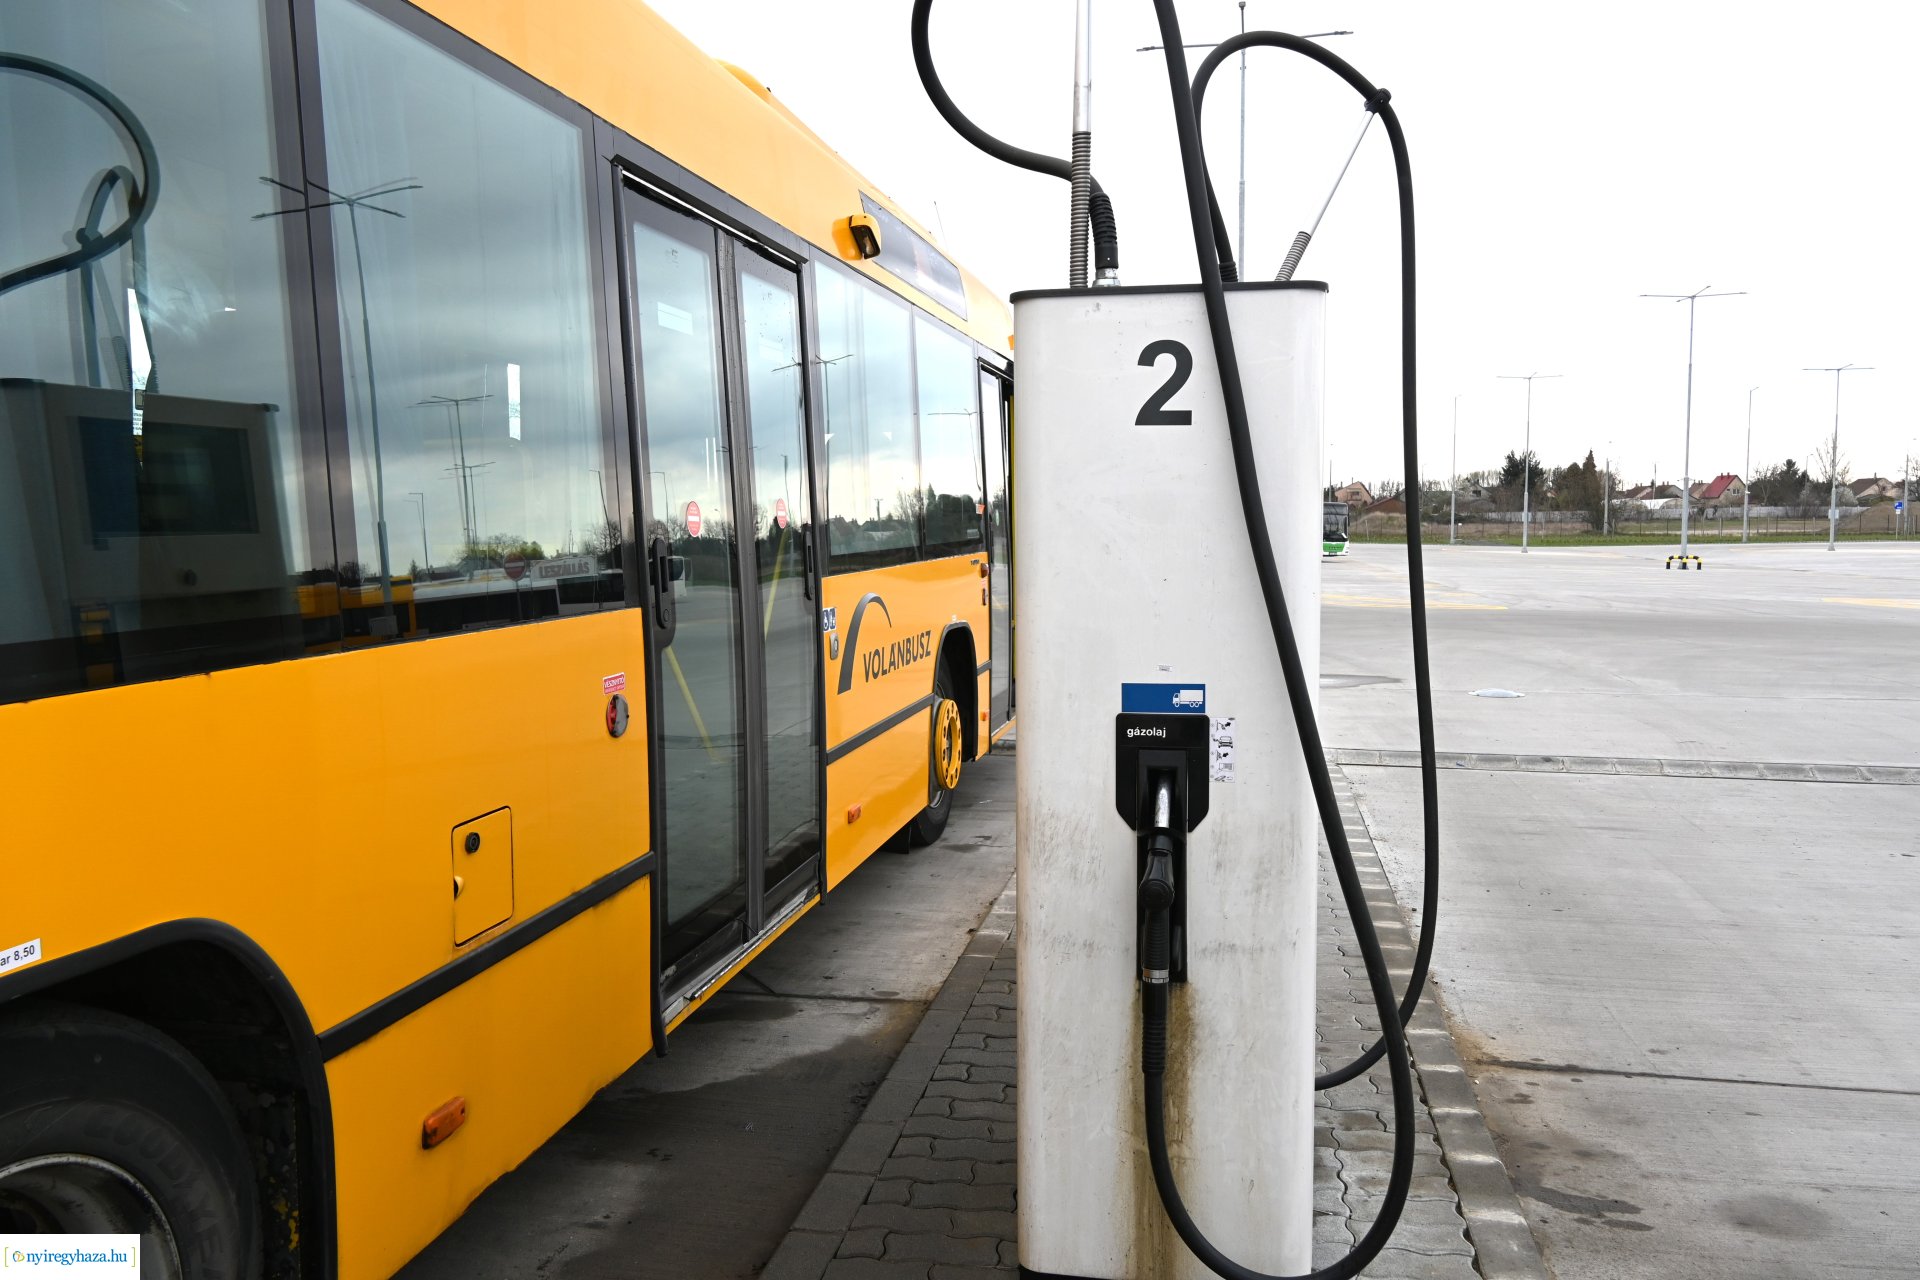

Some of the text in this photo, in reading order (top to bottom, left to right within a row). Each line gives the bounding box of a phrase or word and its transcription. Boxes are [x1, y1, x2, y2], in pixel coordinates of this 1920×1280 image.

[1134, 339, 1193, 426] 2
[863, 630, 932, 683] VOLÁNBUSZ
[1126, 727, 1167, 739] gázolaj
[13, 945, 35, 961] 8,50
